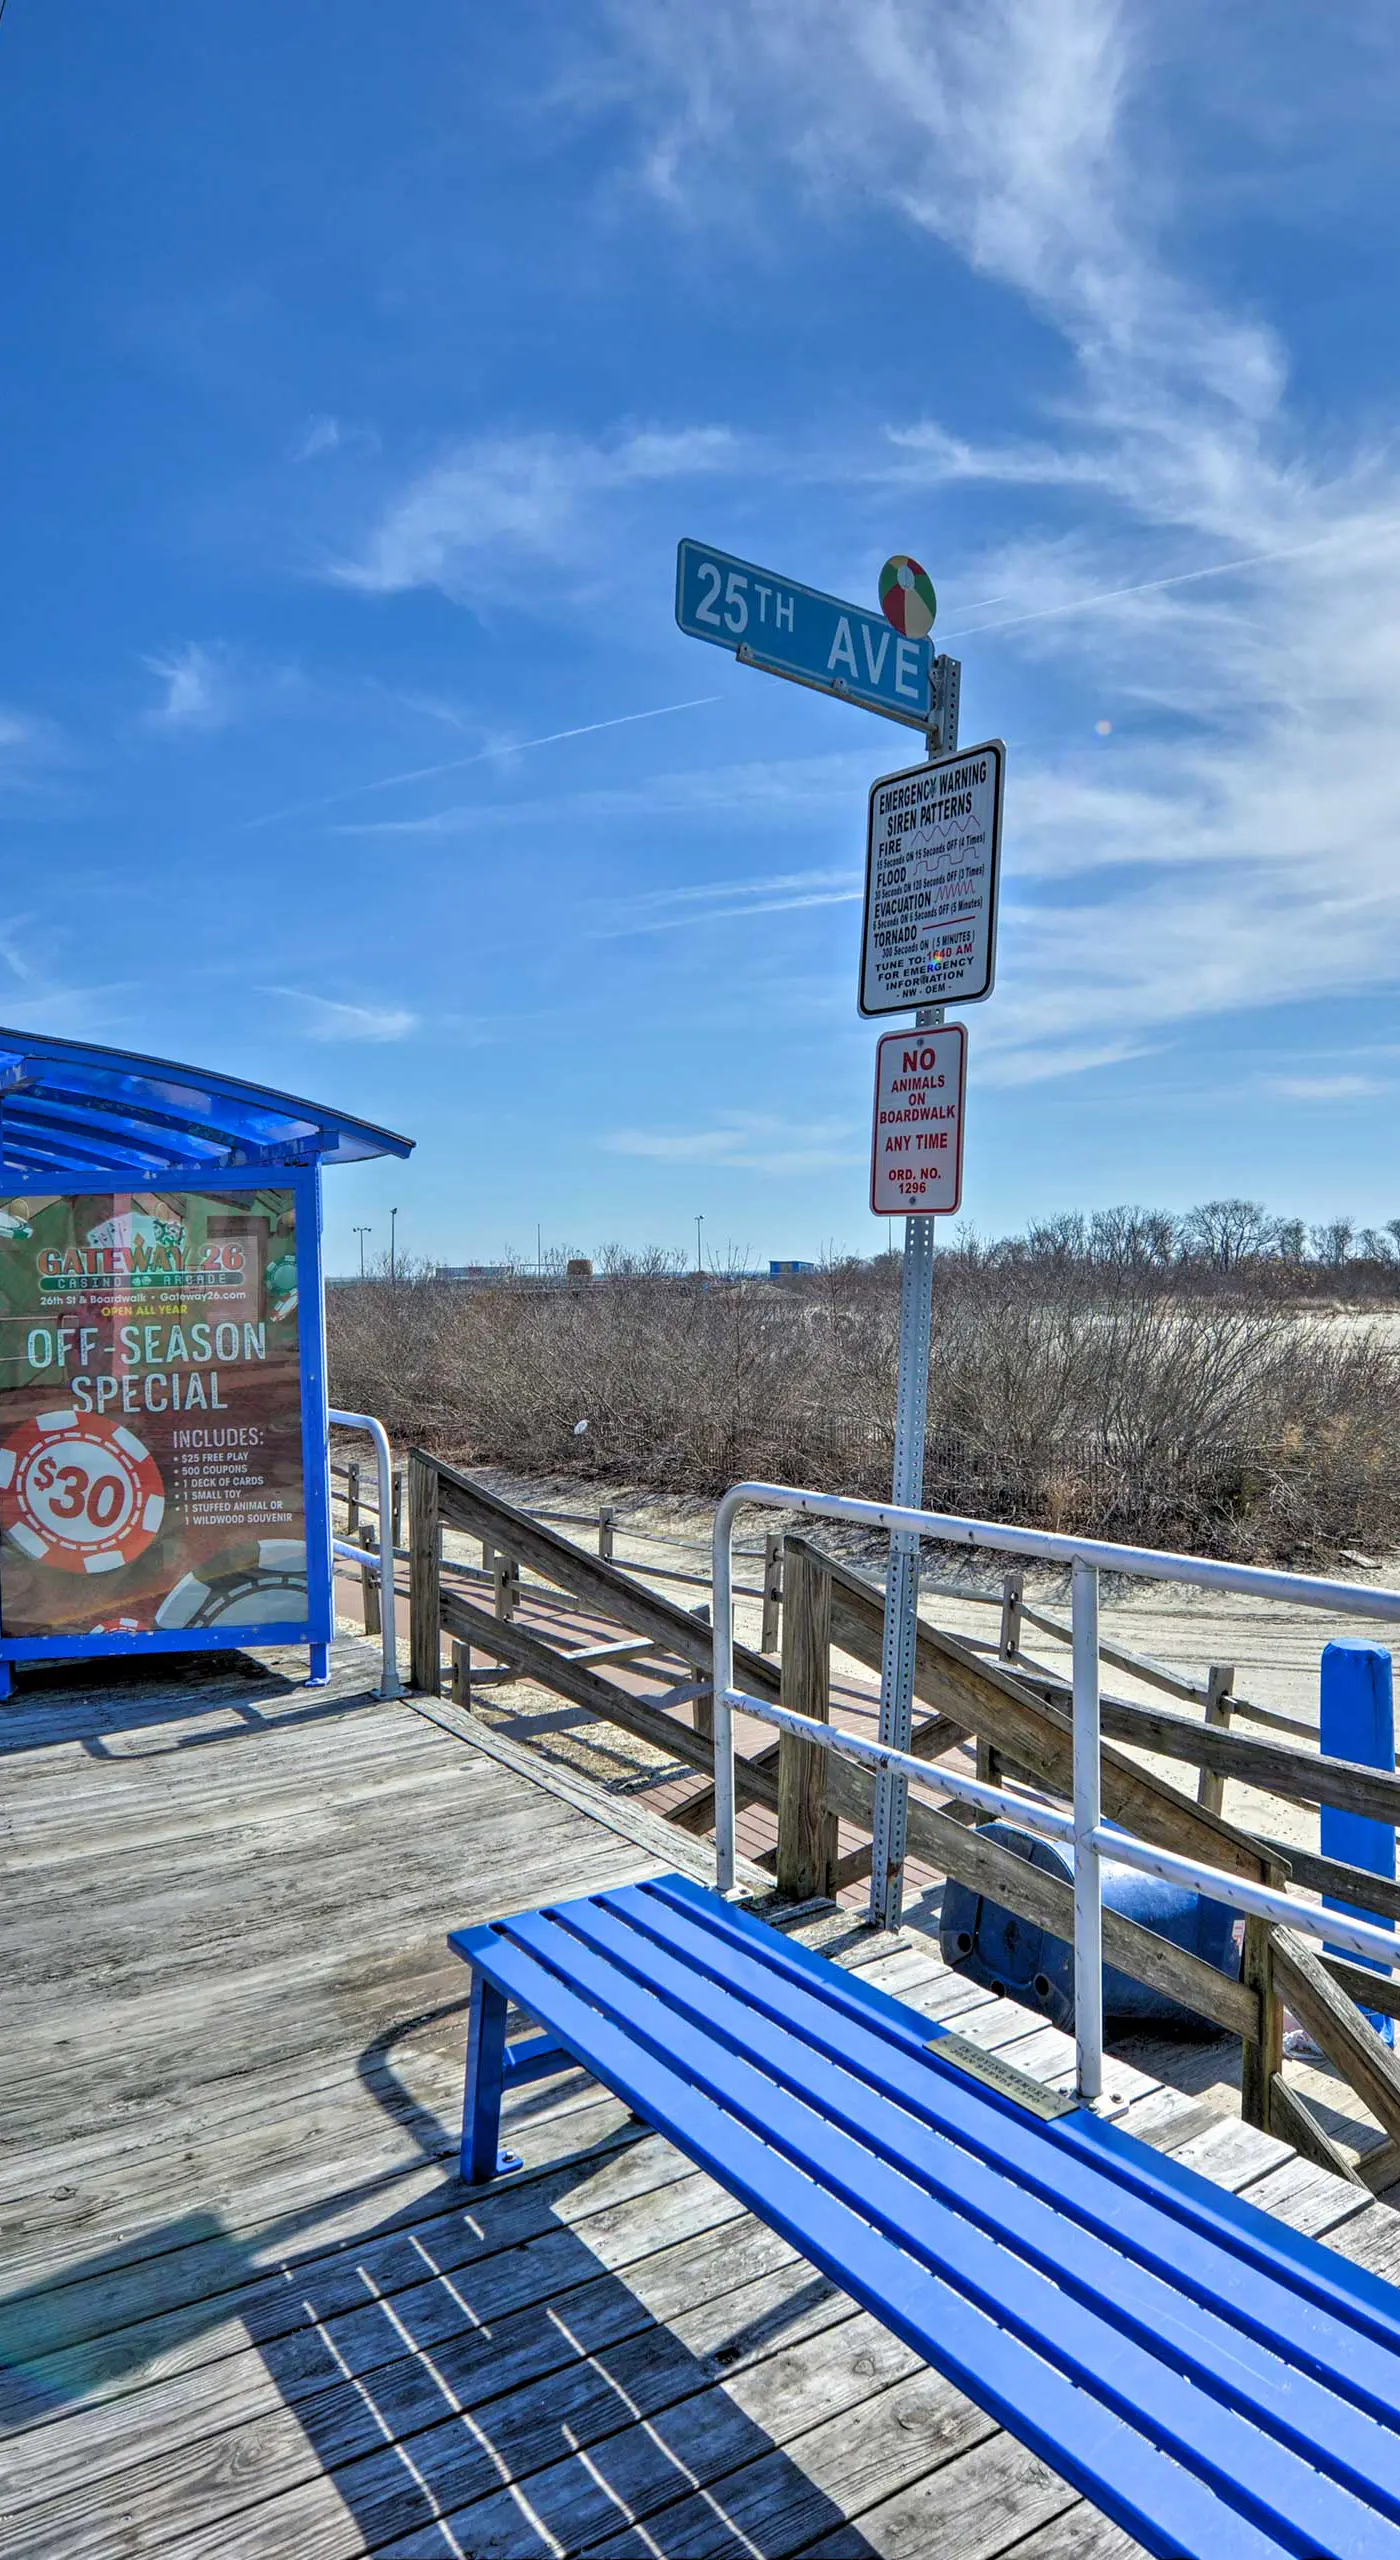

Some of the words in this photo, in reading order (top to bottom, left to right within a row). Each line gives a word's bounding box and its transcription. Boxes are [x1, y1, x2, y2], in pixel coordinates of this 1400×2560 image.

[695, 563, 794, 633] 25TH
[827, 616, 920, 699] AVE
[880, 777, 936, 815] EMERGENCY
[940, 760, 987, 795] WARNING
[887, 808, 917, 837] SIREN
[920, 792, 972, 827] PATTERNS
[879, 838, 901, 858] FIRE
[906, 851, 914, 862] ON
[923, 843, 945, 857] Seconds
[947, 838, 958, 851] OFF
[877, 867, 906, 889] FLOOD
[923, 874, 945, 888] Seconds
[947, 870, 958, 882] OFF
[874, 891, 931, 919] EVACUATION
[900, 913, 908, 924] ON
[915, 907, 937, 921] Seconds
[939, 903, 950, 915] OFF
[874, 925, 917, 949] TORNADO
[875, 960, 904, 972] TUNE
[908, 956, 925, 966] TO:
[956, 943, 973, 955] AM
[894, 943, 918, 956] Seconds
[920, 939, 929, 950] ON
[878, 971, 899, 982] FOR
[904, 956, 974, 977] EMERGENCY
[902, 989, 917, 998] NW
[925, 983, 946, 994] OEM
[903, 1048, 936, 1073] NO
[891, 1075, 945, 1093] ANIMALS
[908, 1092, 925, 1106] ON
[880, 1104, 956, 1124] BOARDWALK
[885, 1134, 912, 1152] ANY
[916, 1132, 948, 1150] TIME
[888, 1168, 916, 1181] ORD.
[920, 1167, 941, 1180] NO.
[898, 1182, 926, 1194] 1296
[39, 1245, 188, 1275] GATEWAY
[201, 1243, 245, 1271] 26
[57, 1277, 121, 1289] CASINO
[163, 1273, 227, 1285] ARCADE
[40, 1295, 63, 1305] 26th
[66, 1295, 76, 1304] St
[90, 1293, 146, 1304] Boardwalk
[160, 1291, 246, 1303] Gateway26.com
[101, 1306, 133, 1316] OPEN
[136, 1305, 156, 1315] ALL
[159, 1304, 188, 1314] YEAR
[27, 1322, 266, 1369] OFF-SEASON
[71, 1371, 228, 1414] SPECIAL
[173, 1427, 264, 1448] INCLUDES:
[181, 1453, 199, 1463] $25
[202, 1453, 224, 1462] FREE
[226, 1452, 249, 1461] PLAY
[181, 1466, 200, 1476] 500
[202, 1464, 248, 1475] COUPONS
[33, 1456, 125, 1527] $30
[183, 1479, 188, 1488] 1
[191, 1478, 217, 1488] DECK
[218, 1477, 231, 1487] OF
[232, 1476, 264, 1486] CARDS
[183, 1492, 188, 1501] 1
[191, 1491, 222, 1501] SMALL
[224, 1490, 242, 1499] TOY
[184, 1504, 188, 1513] 1
[191, 1503, 231, 1513] STUFFED
[233, 1501, 268, 1511] ANIMAL
[270, 1500, 284, 1510] OR
[193, 1515, 245, 1525] WILDWOOD
[247, 1513, 293, 1524] SOUVENIR
[970, 2052, 1007, 2075] LOVING
[1007, 2074, 1050, 2100] MEMORY
